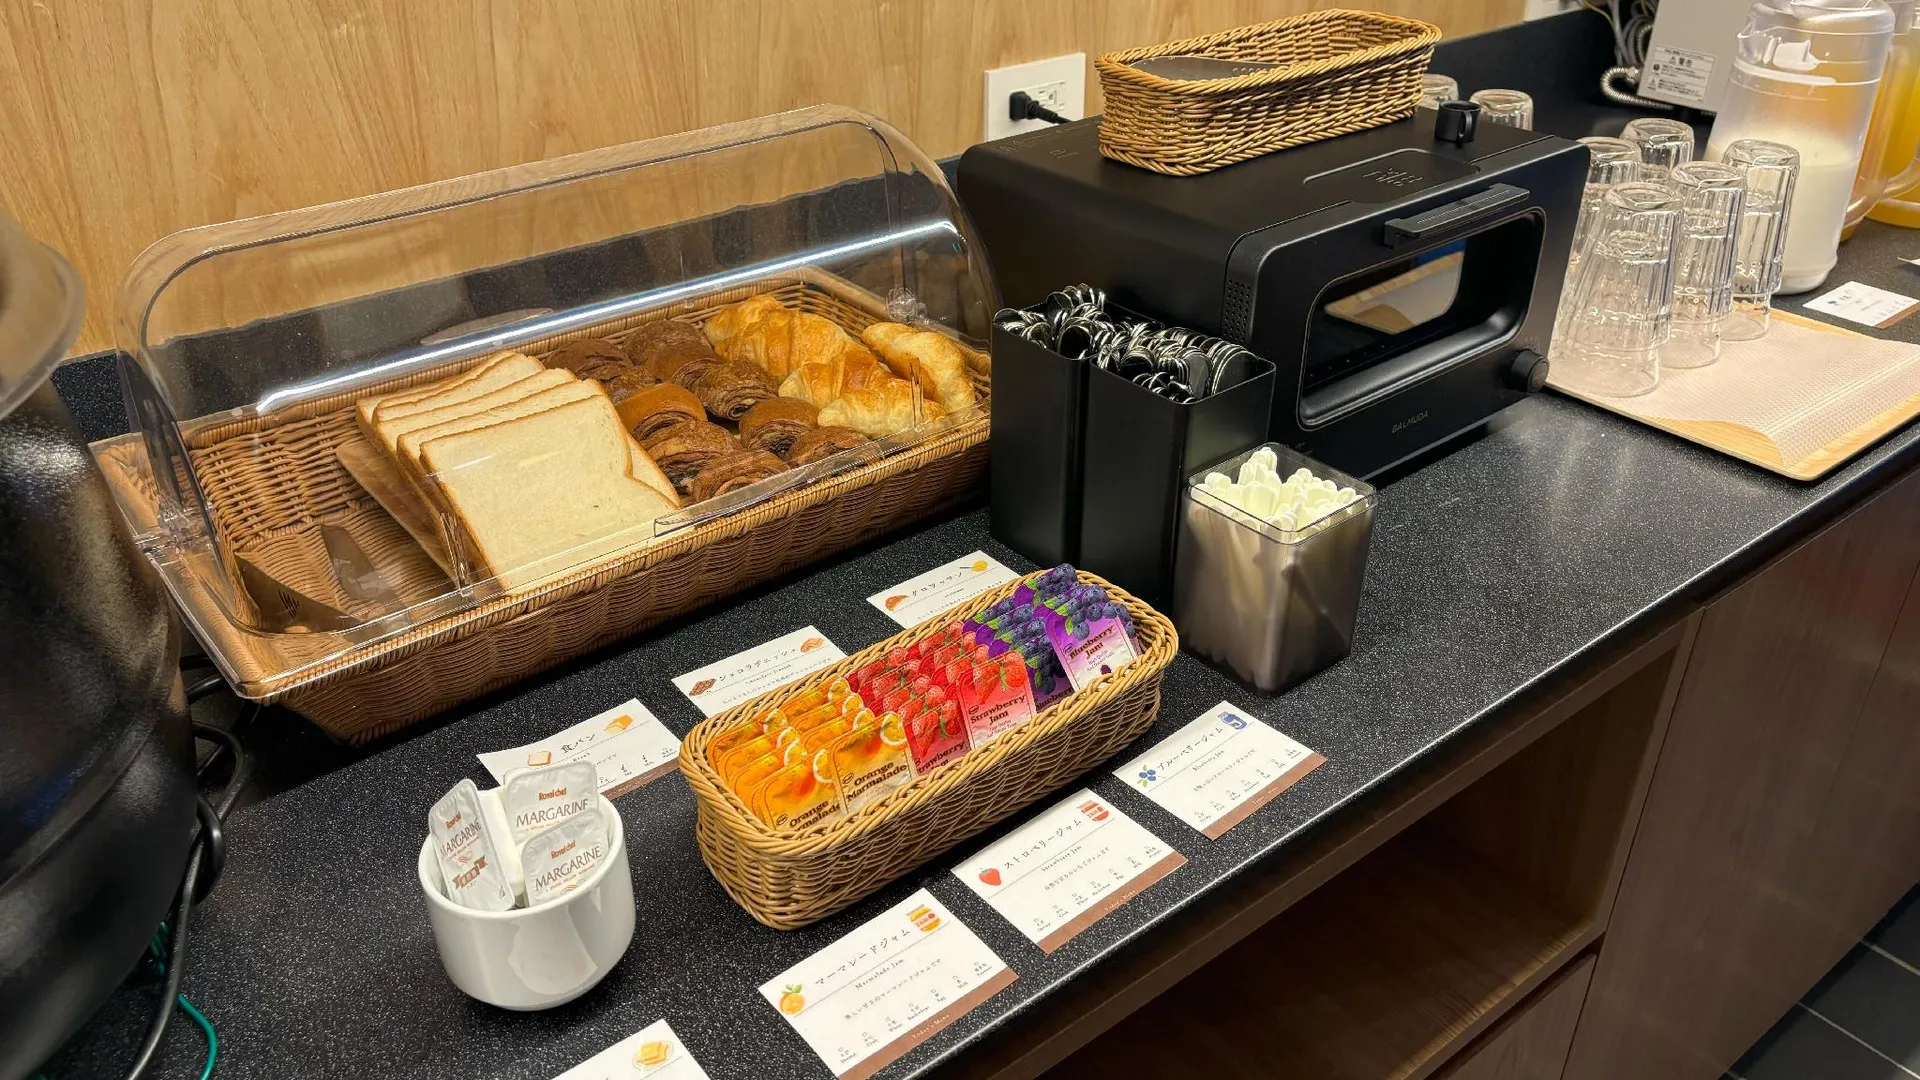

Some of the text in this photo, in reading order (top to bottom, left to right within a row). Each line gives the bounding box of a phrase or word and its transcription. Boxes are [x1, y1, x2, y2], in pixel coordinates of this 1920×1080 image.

[1392, 410, 1428, 433] BALMUDA
[1069, 626, 1113, 660] Blueberry
[1086, 642, 1104, 660] Jam
[971, 695, 1025, 724] Strawberry
[990, 710, 1009, 724] Jam
[561, 733, 595, 754] 食パン
[919, 741, 965, 773] trawberry
[1157, 727, 1224, 772] ブルーベリージャム
[846, 764, 907, 801] Marmalade
[854, 762, 894, 787] Orange
[516, 798, 589, 828] MARGARINE
[789, 800, 829, 827] Orange
[551, 840, 576, 859] Royal chef
[1004, 819, 1082, 870] ストロベリージャム
[535, 845, 602, 892] MARGARINE
[815, 929, 911, 985] マーマレードジャム
[891, 959, 904, 968] Jam
